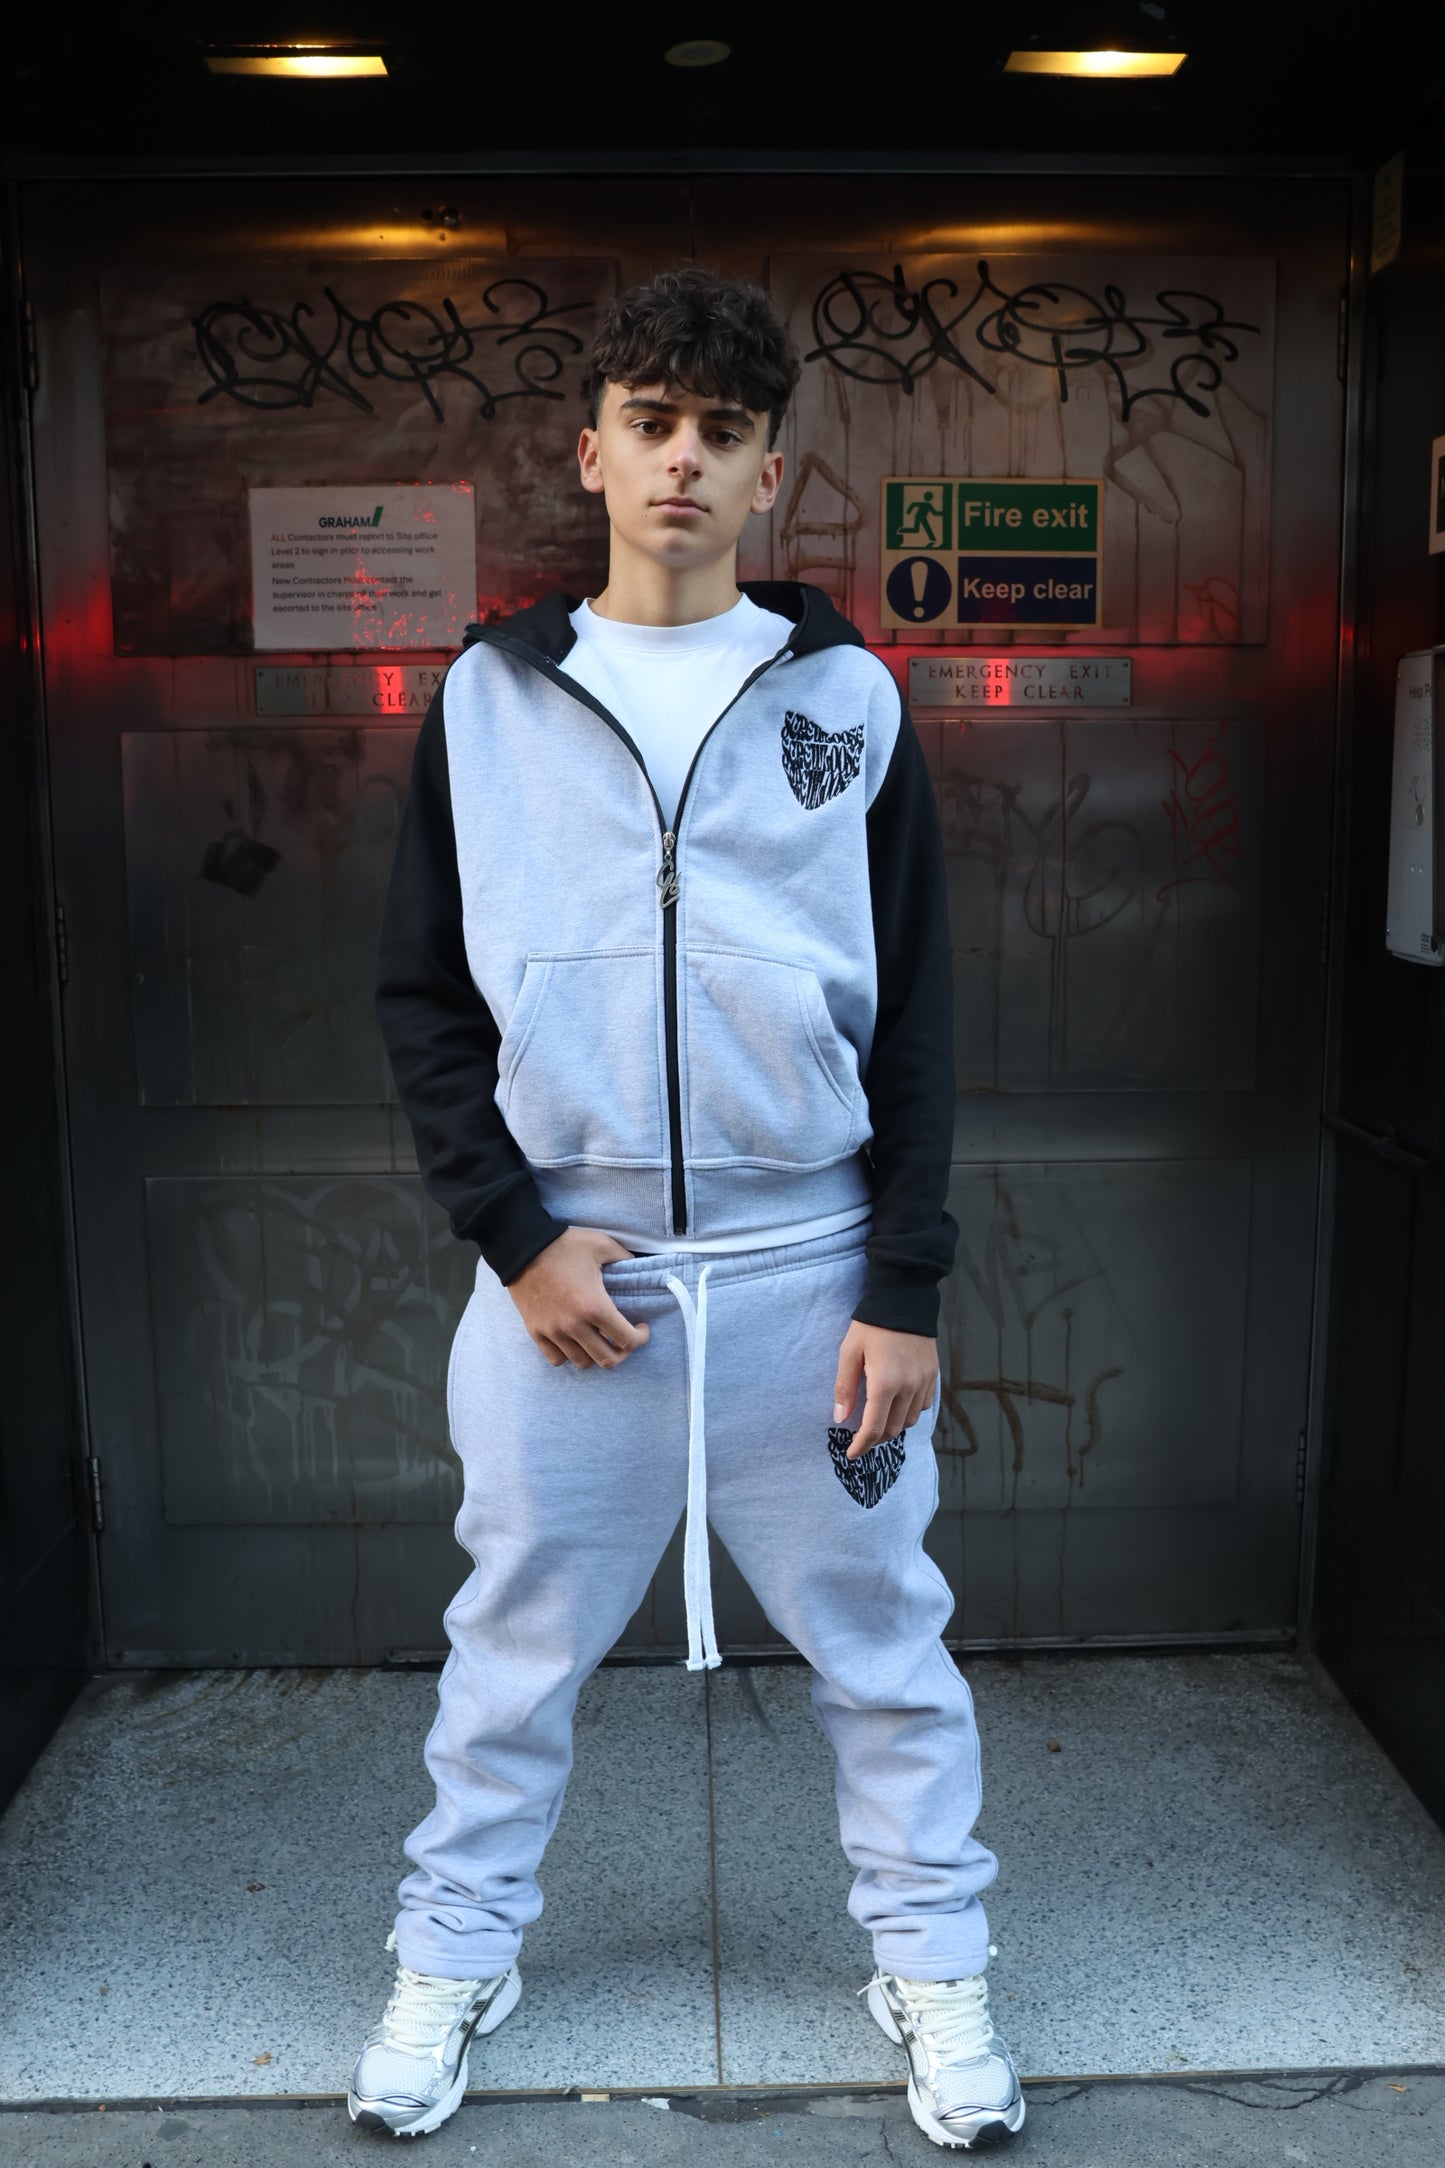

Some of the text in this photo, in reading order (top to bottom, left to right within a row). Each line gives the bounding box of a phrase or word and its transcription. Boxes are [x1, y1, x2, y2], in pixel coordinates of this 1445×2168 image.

[318, 516, 371, 528] GRAHAM
[964, 501, 1089, 529] Fire exit
[271, 533, 286, 542] ALL
[336, 532, 358, 541] must
[359, 532, 384, 543] report
[386, 532, 395, 541] to
[396, 531, 412, 541] Site
[414, 530, 438, 541] office
[271, 544, 435, 558] Level 2 to sign in prior to accessing work
[271, 561, 295, 570] areas
[272, 577, 291, 586] New
[292, 575, 342, 585] Contractors
[399, 575, 414, 584] the
[273, 590, 316, 602] supervisor
[317, 589, 326, 598] in
[326, 589, 354, 601] charge
[389, 589, 410, 598] work
[411, 588, 428, 598] and
[429, 588, 442, 599] get
[963, 577, 1093, 604] Keep clear
[273, 602, 378, 613] escorted to the site office
[928, 664, 1112, 680] EMERGENCY EXIT
[955, 684, 1085, 700] KEEP CLEAR
[373, 692, 433, 707] CLEAR
